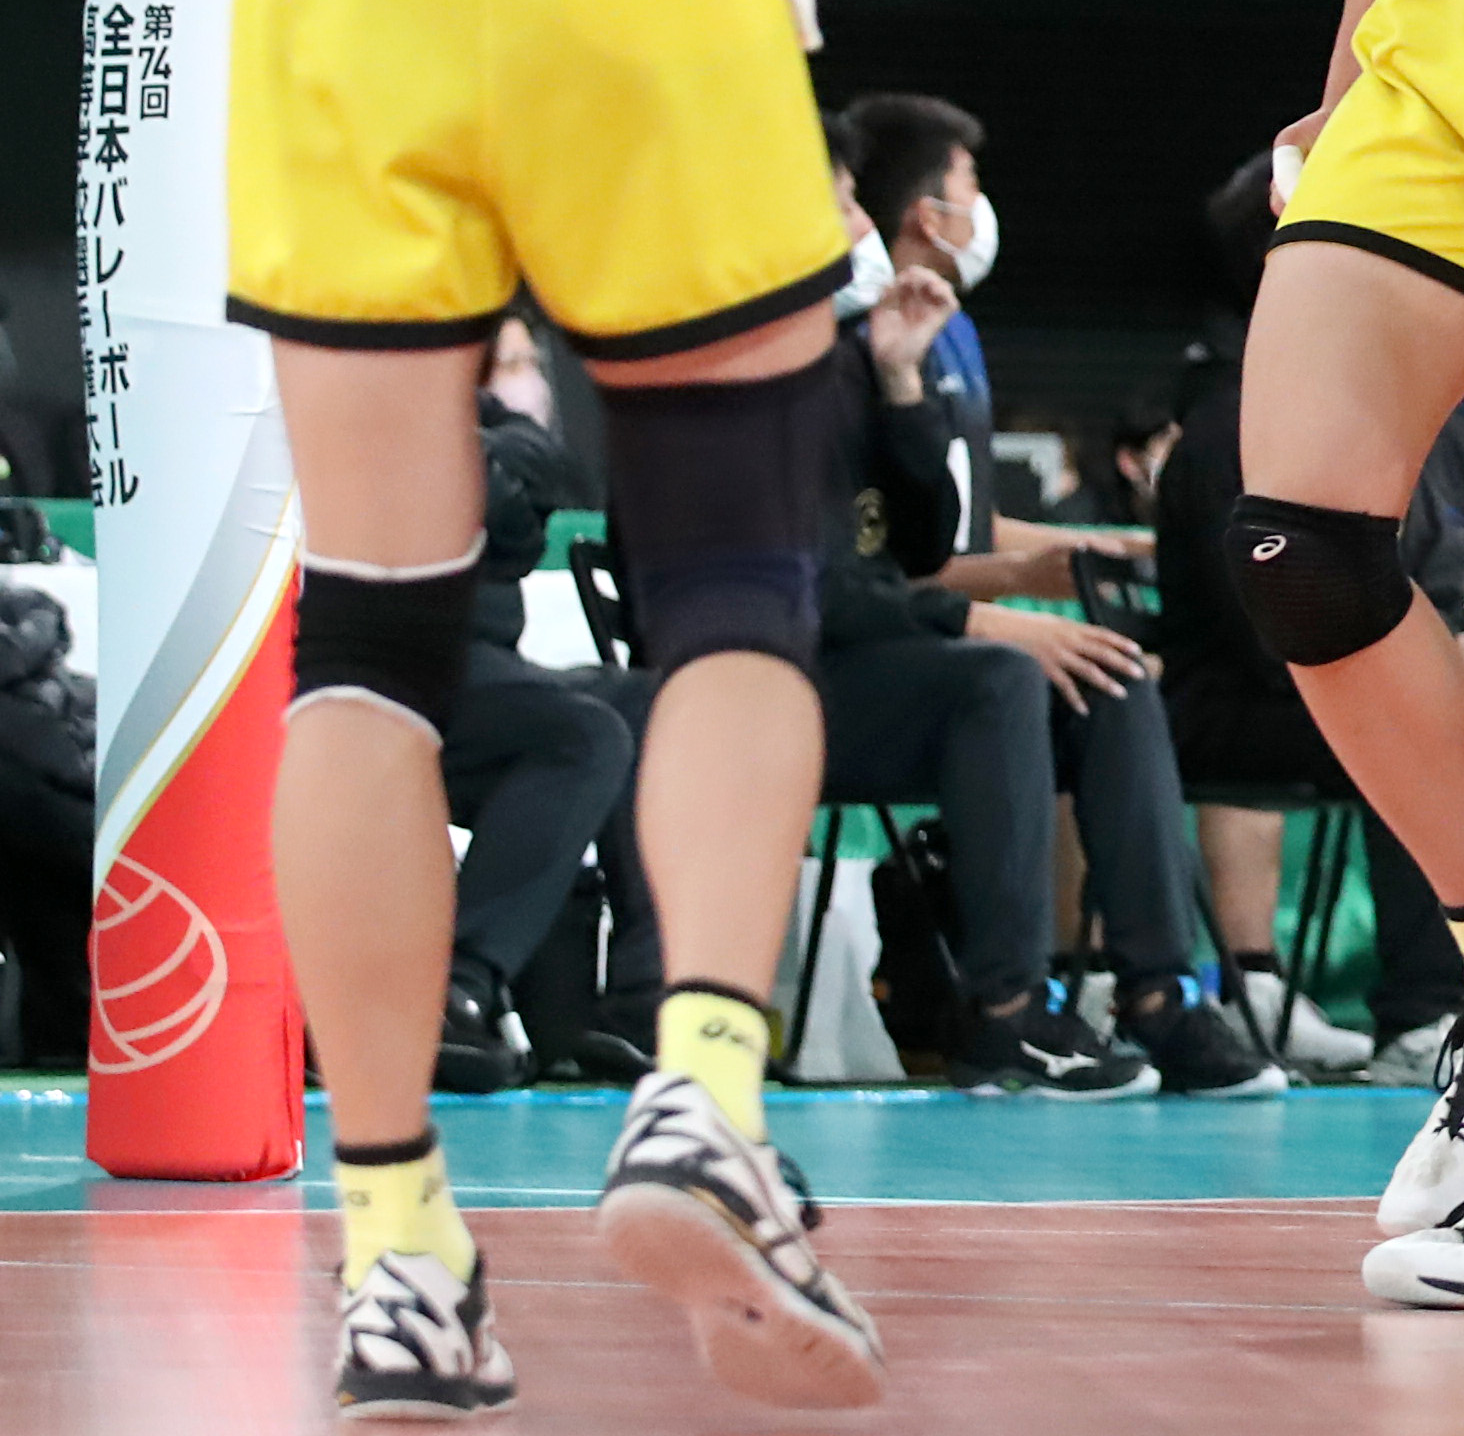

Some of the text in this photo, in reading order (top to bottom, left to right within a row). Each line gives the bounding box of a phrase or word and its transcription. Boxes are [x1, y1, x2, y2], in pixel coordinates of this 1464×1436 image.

[139, 4, 175, 120] 第74回
[93, 3, 139, 506] 全日本バレーボール
